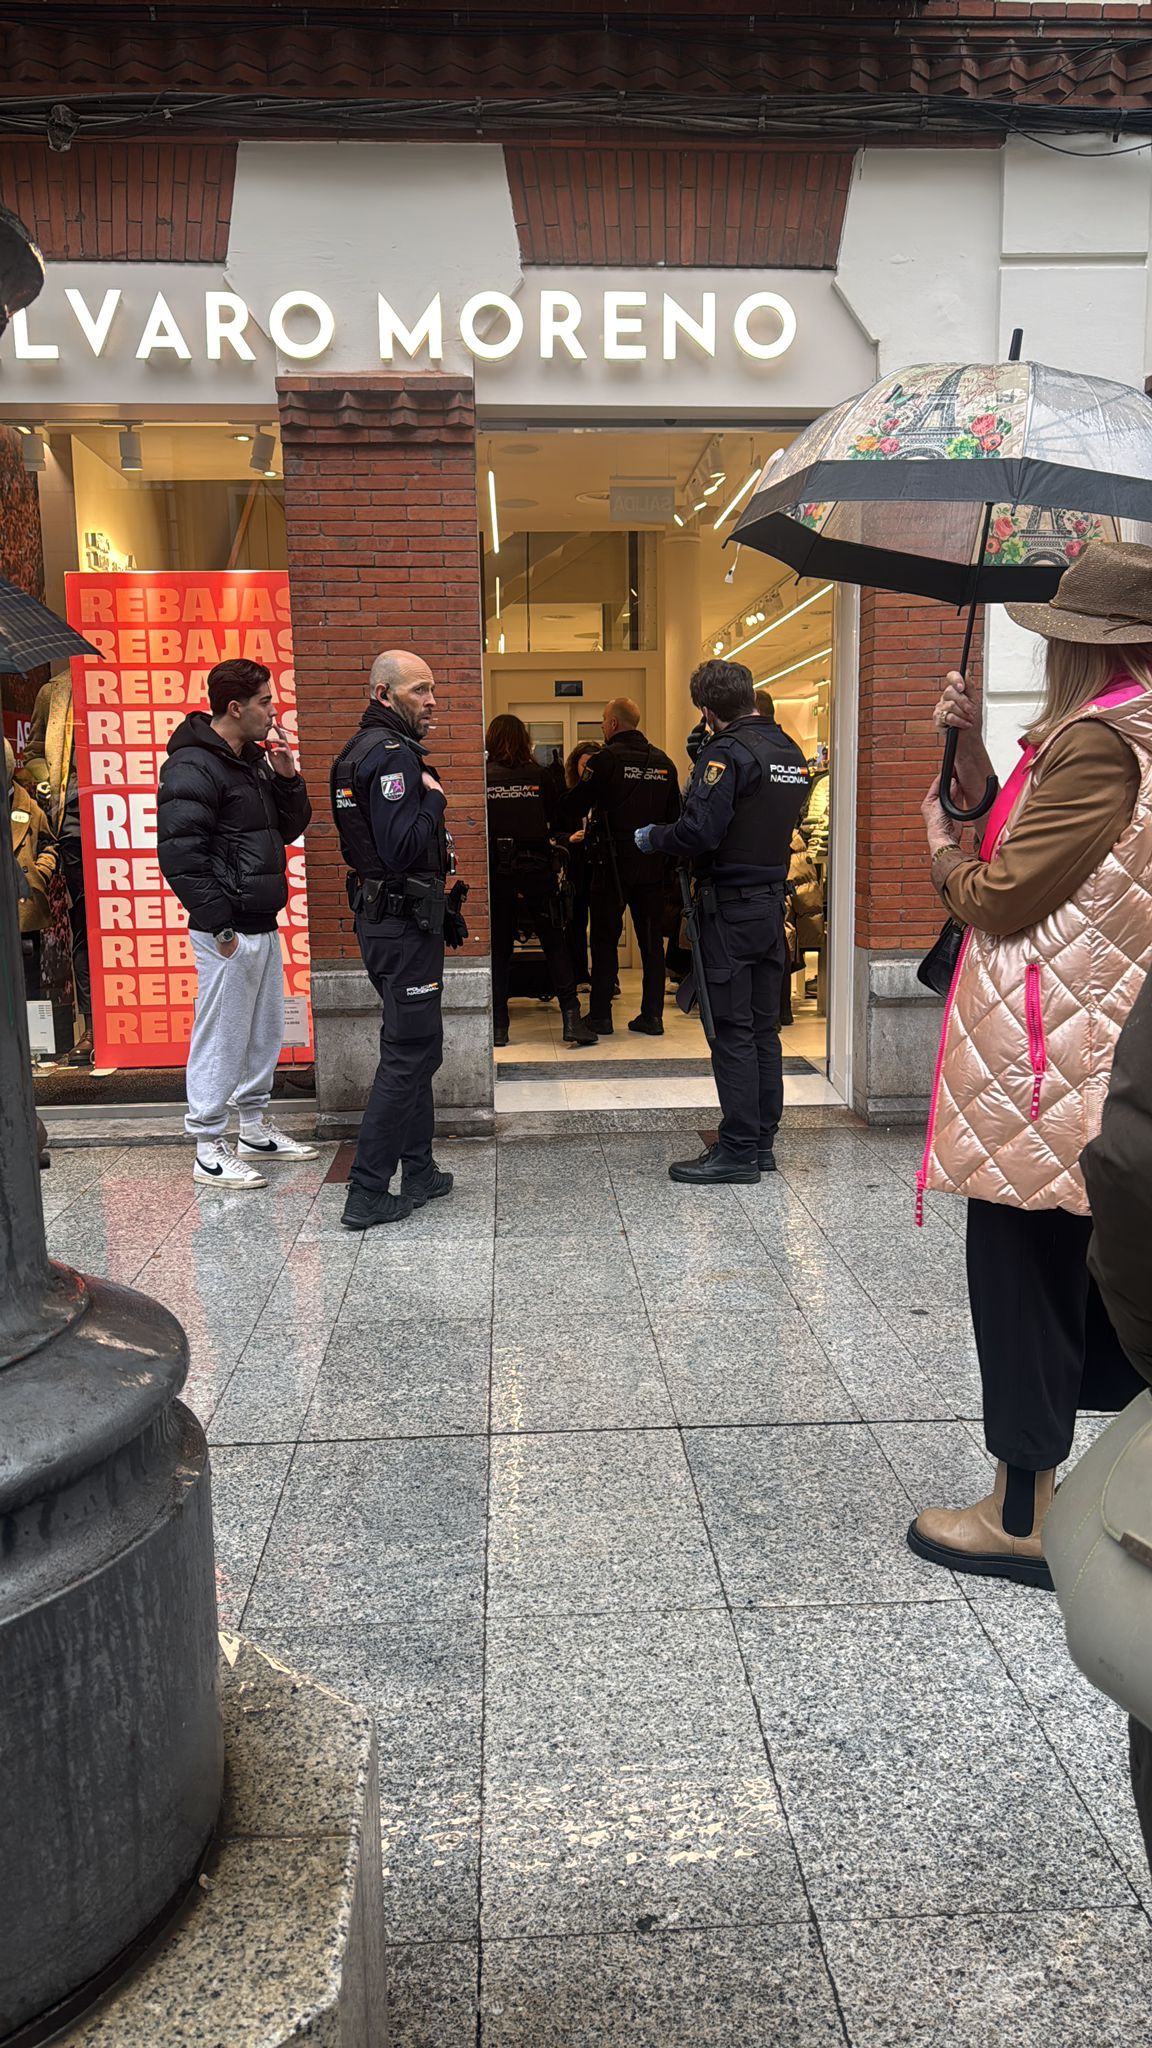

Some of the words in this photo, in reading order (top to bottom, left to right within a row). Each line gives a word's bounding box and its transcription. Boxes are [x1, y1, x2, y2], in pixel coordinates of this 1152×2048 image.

[377, 290, 797, 361] MORENO
[770, 764, 801, 774] POLICIA
[624, 773, 668, 781] NACONAL
[770, 775, 809, 784] NACIONAL
[487, 785, 529, 793] POLICIA
[487, 791, 539, 799] NACIONAL
